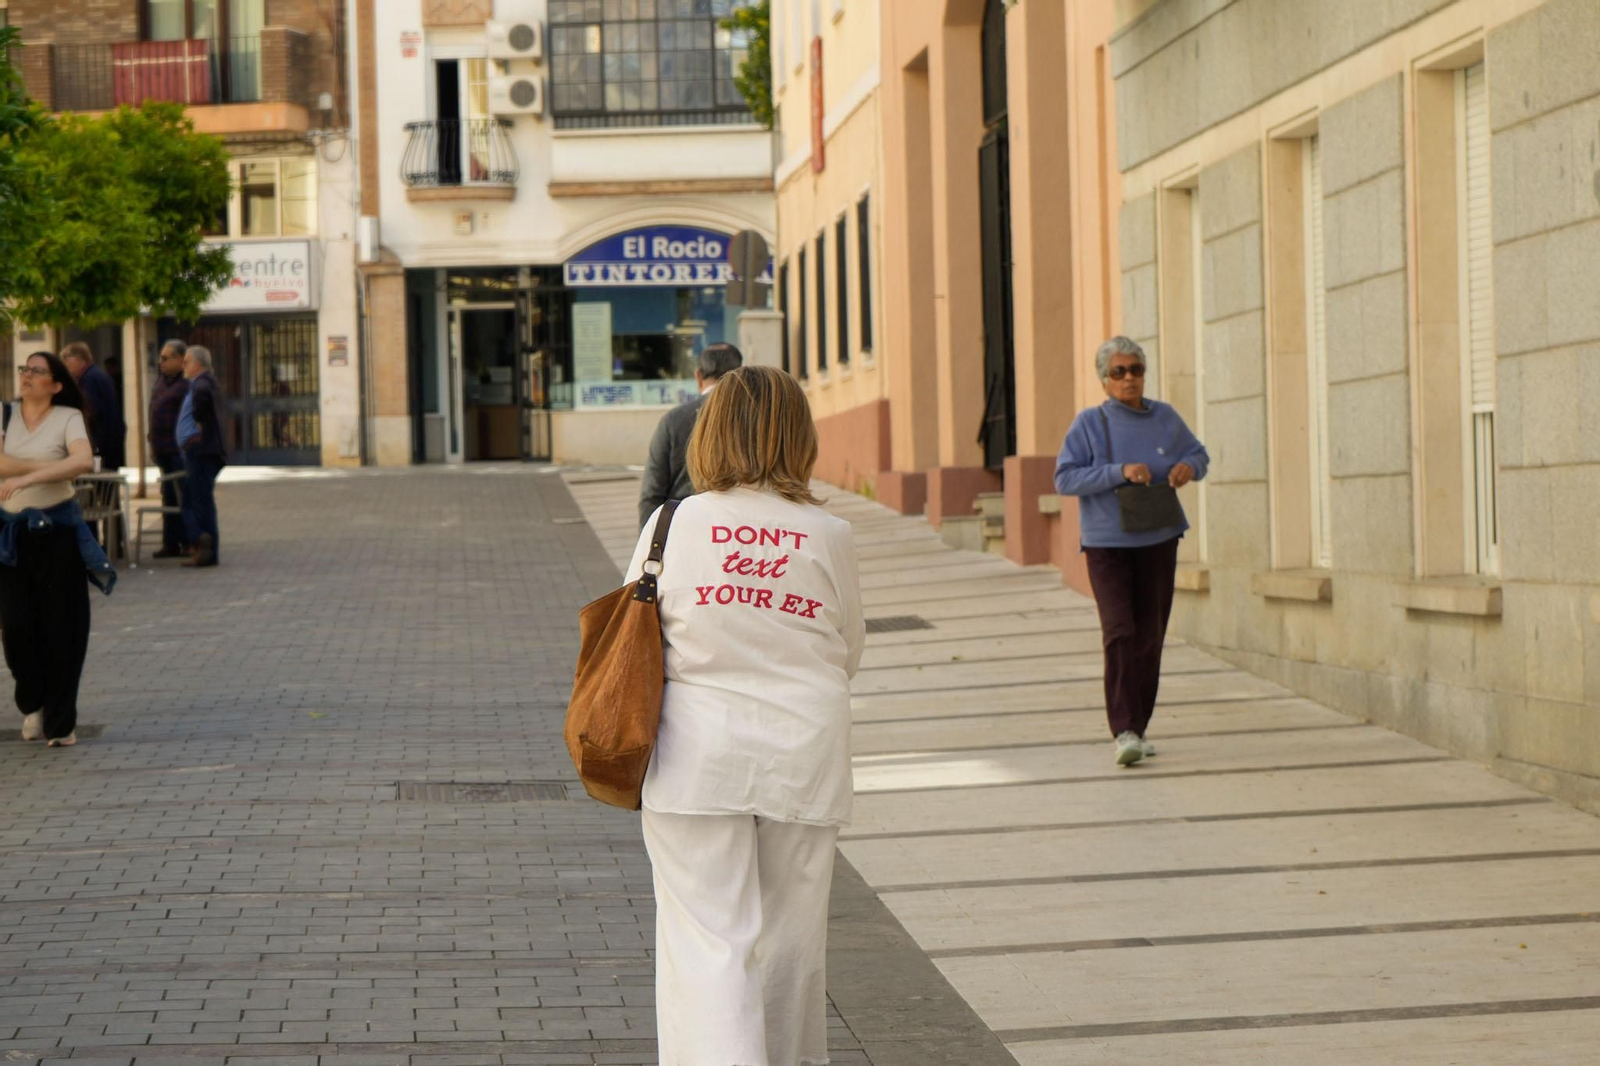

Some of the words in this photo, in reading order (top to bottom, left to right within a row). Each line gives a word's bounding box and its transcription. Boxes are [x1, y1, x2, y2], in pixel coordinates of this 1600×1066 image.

[623, 236, 645, 258] El
[571, 263, 775, 283] TINTORERA
[711, 525, 808, 550] DON'T
[721, 550, 789, 578] text
[695, 584, 773, 609] YOUR
[779, 593, 823, 618] EX
